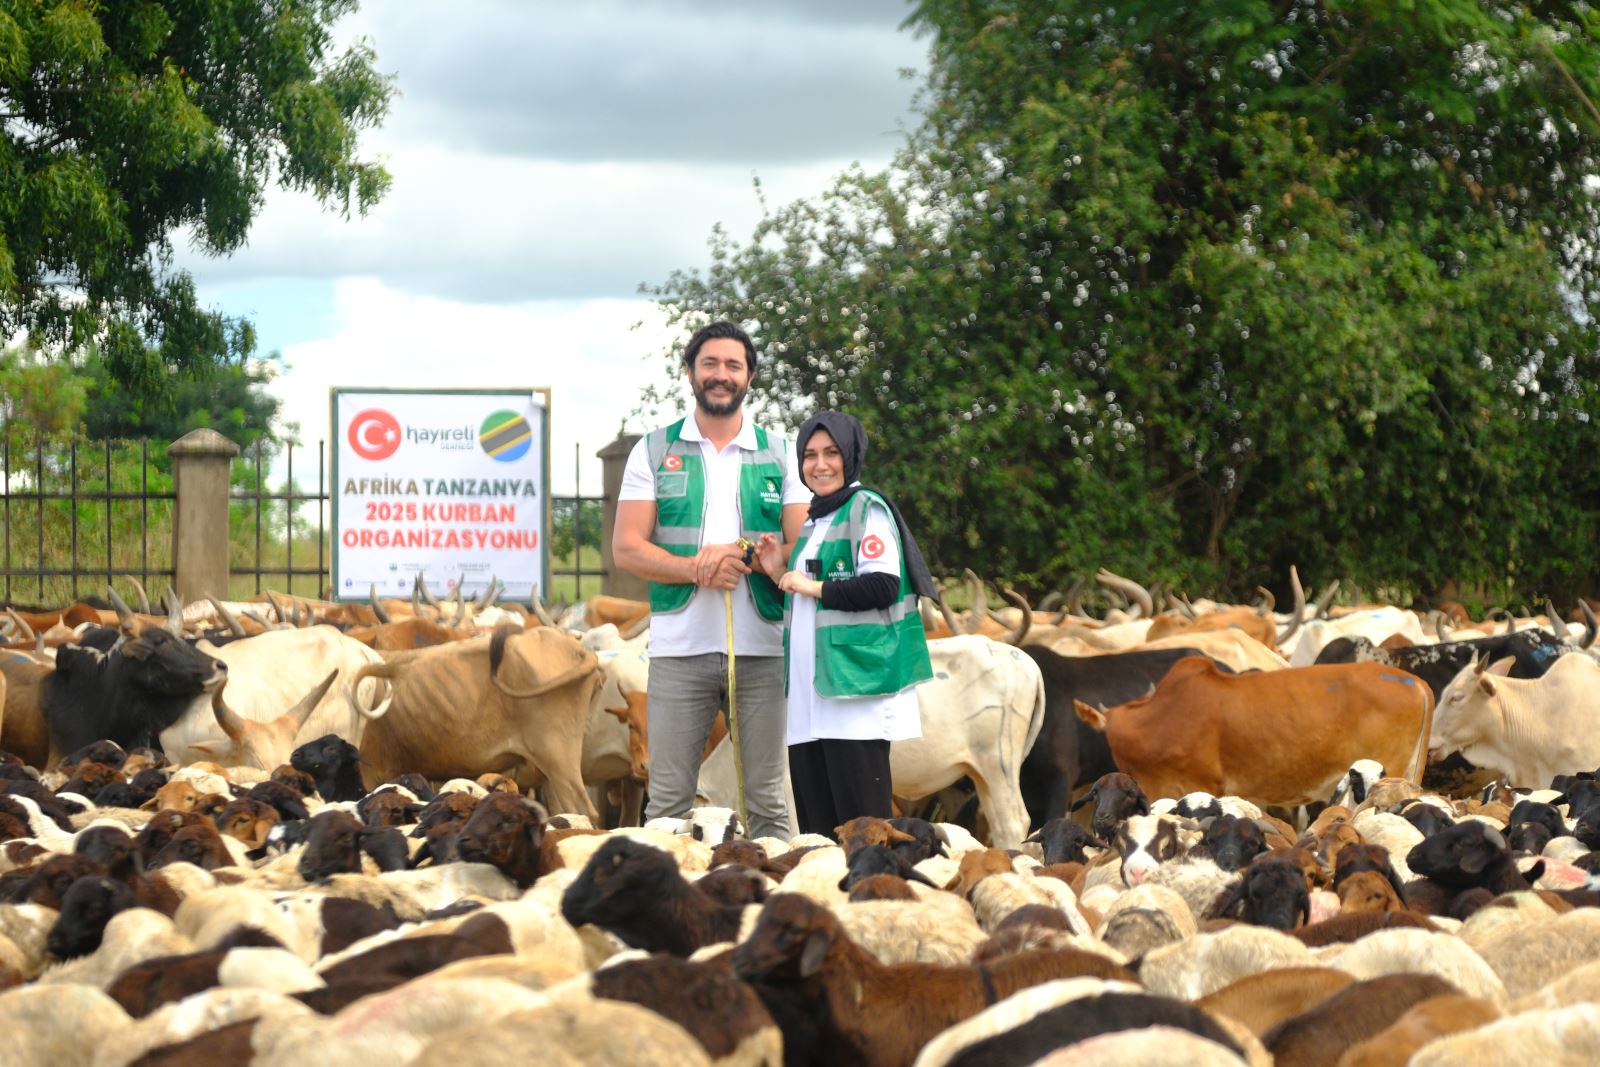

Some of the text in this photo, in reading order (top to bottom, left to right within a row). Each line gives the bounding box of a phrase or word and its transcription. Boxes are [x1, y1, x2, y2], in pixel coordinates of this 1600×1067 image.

[343, 473, 536, 497] AFRİKA TANZANYA
[365, 502, 516, 522] 2025 KURBAN
[342, 523, 539, 549] ORGANİZASYONU
